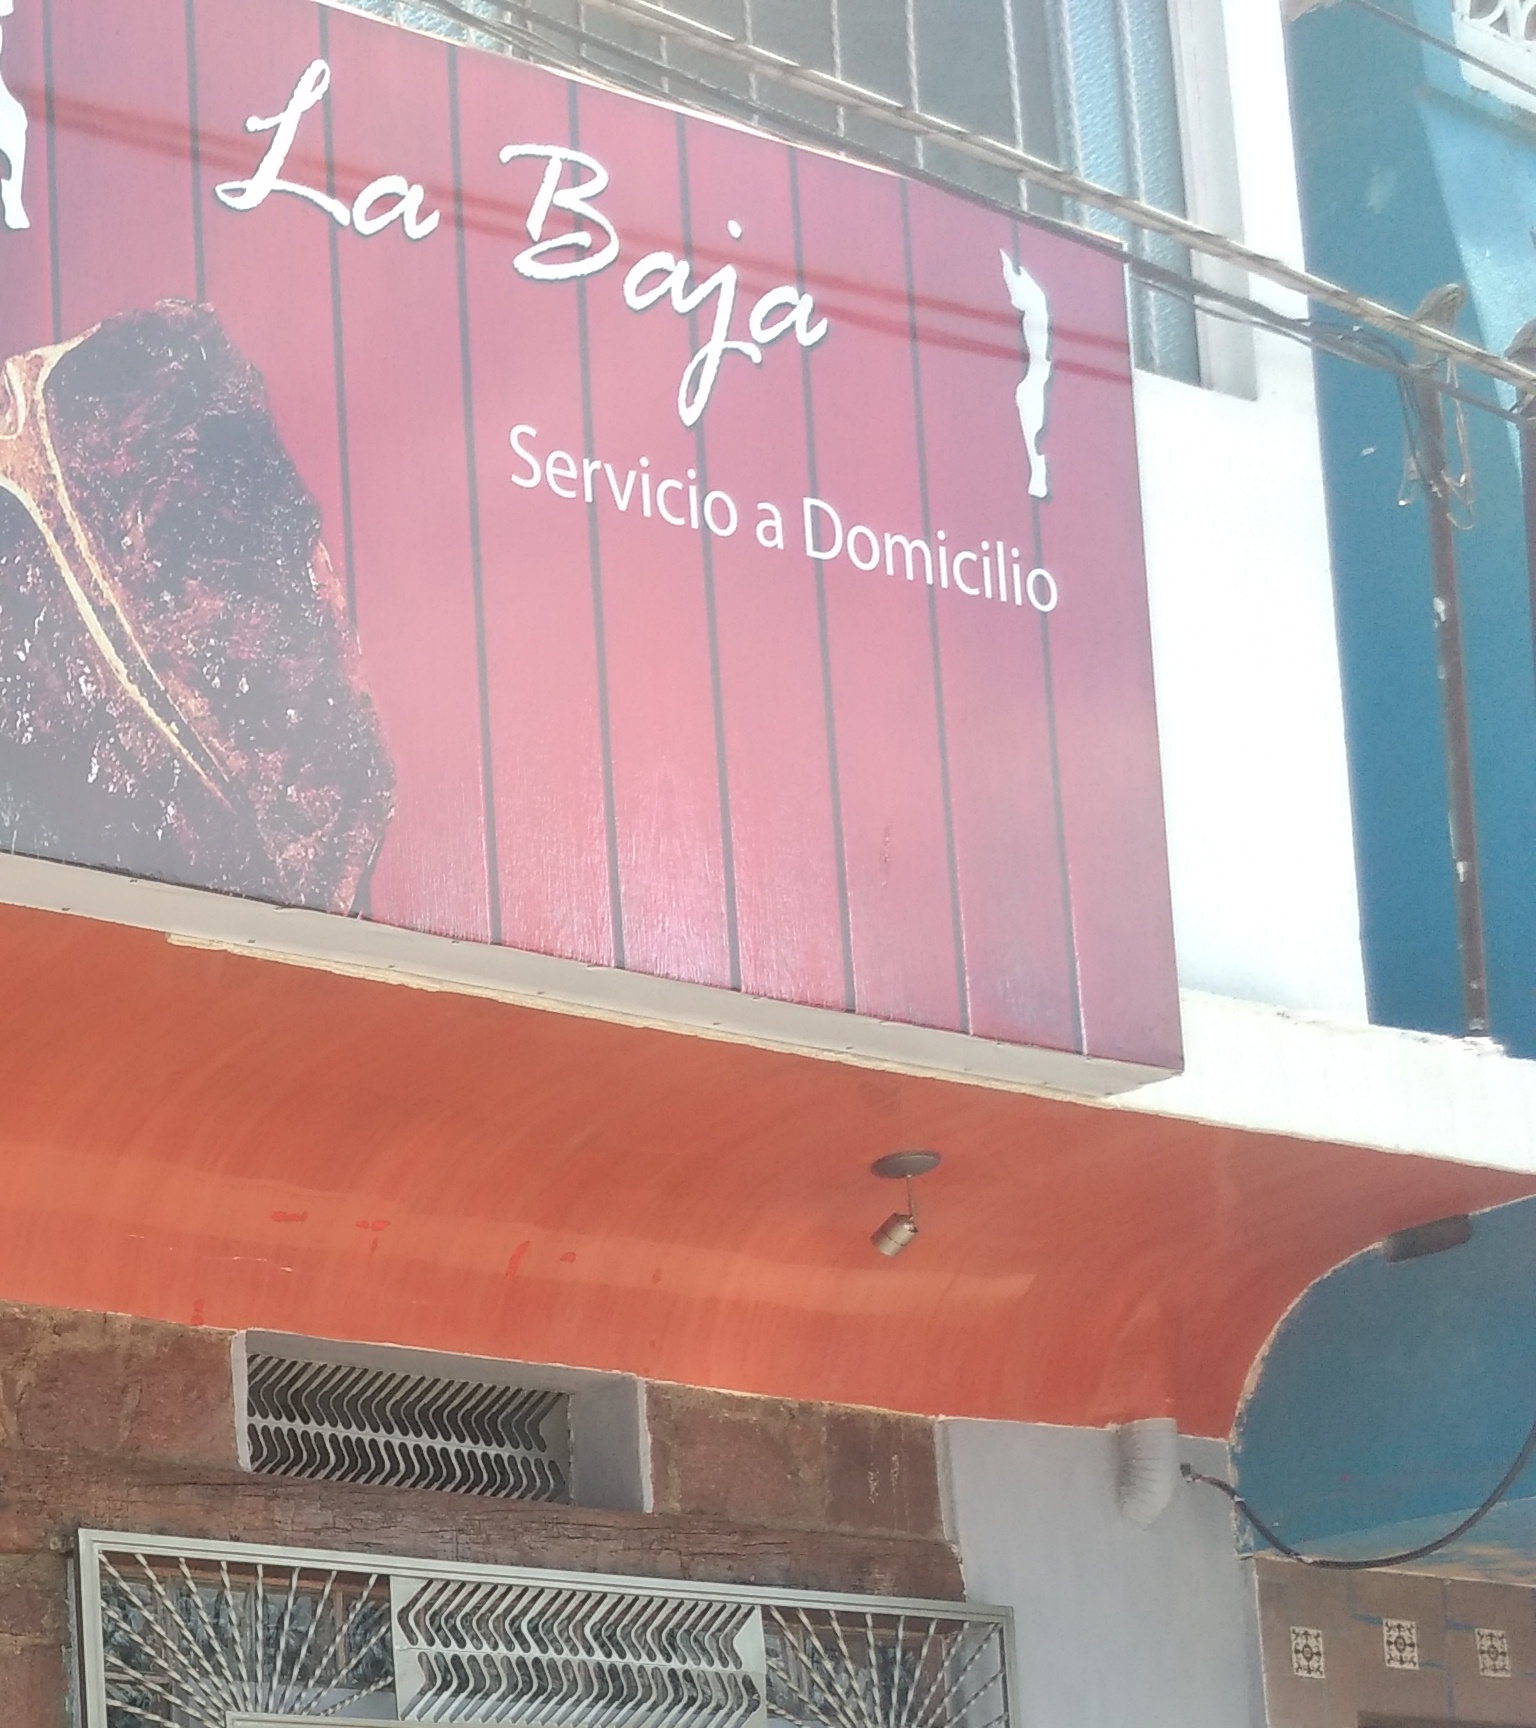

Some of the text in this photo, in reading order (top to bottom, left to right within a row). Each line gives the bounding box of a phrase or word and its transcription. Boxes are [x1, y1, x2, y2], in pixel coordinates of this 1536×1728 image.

[213, 57, 832, 428] La Baja
[507, 422, 1061, 615] Servicio a Domicilio
